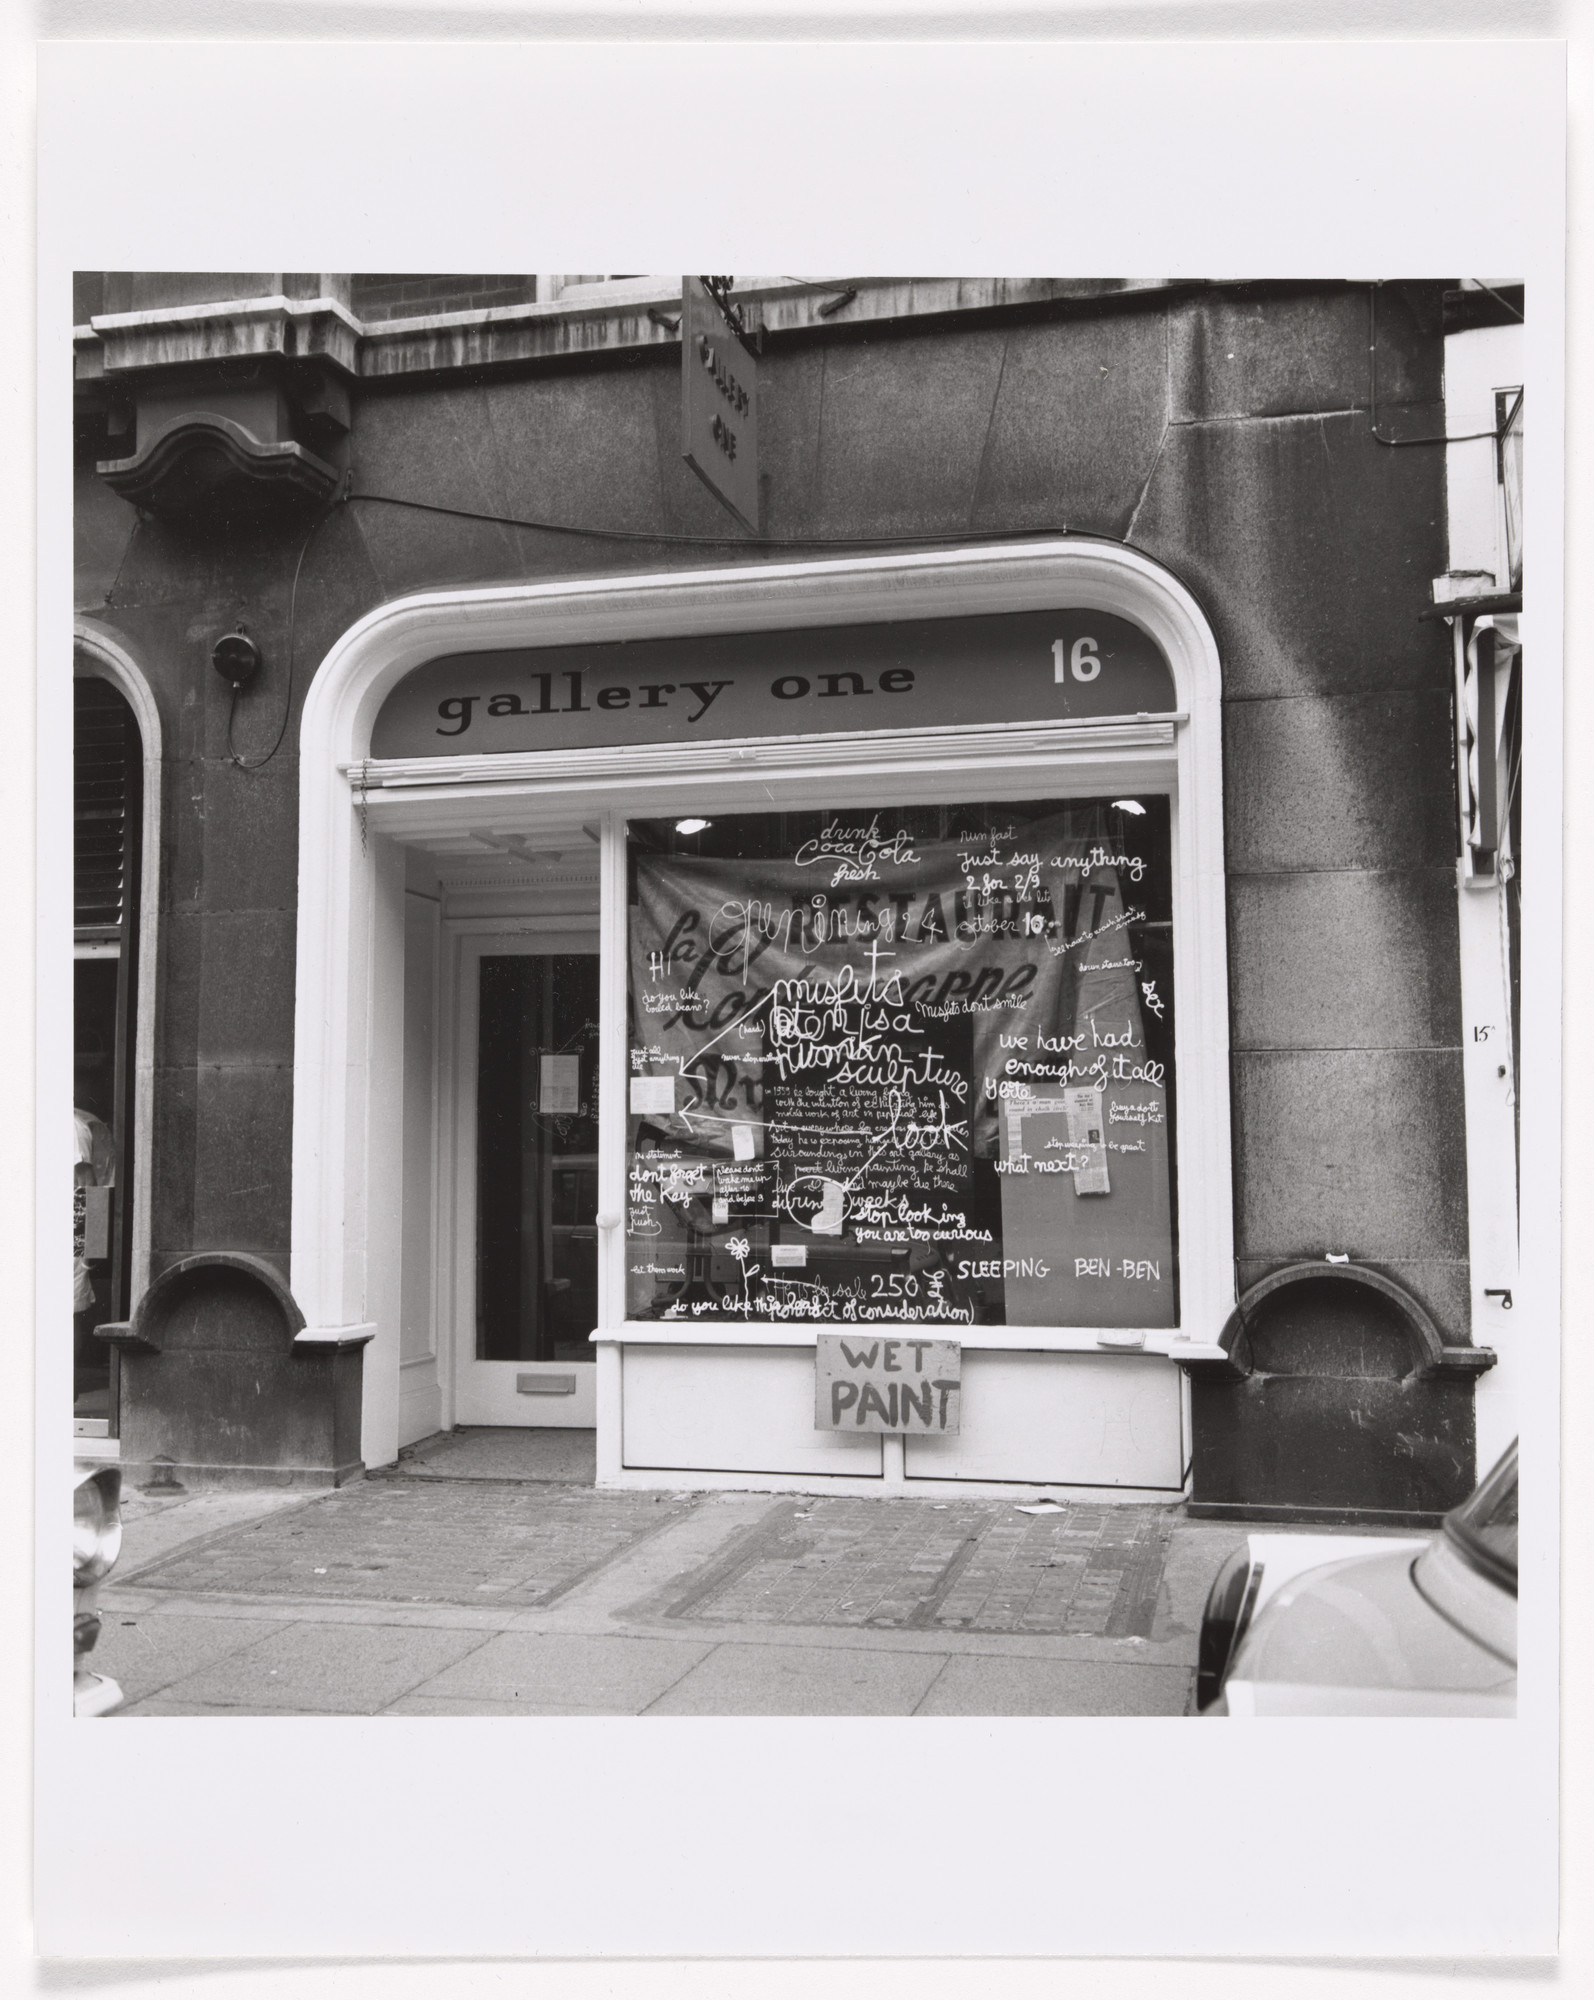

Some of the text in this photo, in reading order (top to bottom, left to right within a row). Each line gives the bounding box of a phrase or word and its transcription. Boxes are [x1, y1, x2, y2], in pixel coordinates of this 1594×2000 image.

[1051, 637, 1101, 684] 16
[435, 668, 916, 737] gallery one
[821, 814, 880, 840] drink
[795, 829, 921, 867] Coca Cola
[1006, 852, 1044, 873] say
[1050, 847, 1147, 881] anything
[966, 875, 981, 890] 2
[981, 872, 1008, 897] for
[679, 986, 701, 1001] like
[999, 1018, 1143, 1052] we have had
[1005, 1053, 1166, 1092] enough of it all
[629, 1163, 708, 1186] dont forget
[993, 1152, 1033, 1177] what
[629, 1183, 657, 1203] the
[771, 1194, 825, 1211] durin
[850, 1204, 900, 1229] stop
[854, 1221, 993, 1244] you are too curious
[956, 1257, 1051, 1280] SLEEPING
[870, 1274, 919, 1299] 250
[670, 1298, 688, 1313] do
[691, 1300, 720, 1316] you
[839, 1339, 934, 1373] WET
[831, 1379, 961, 1430] PAINT
